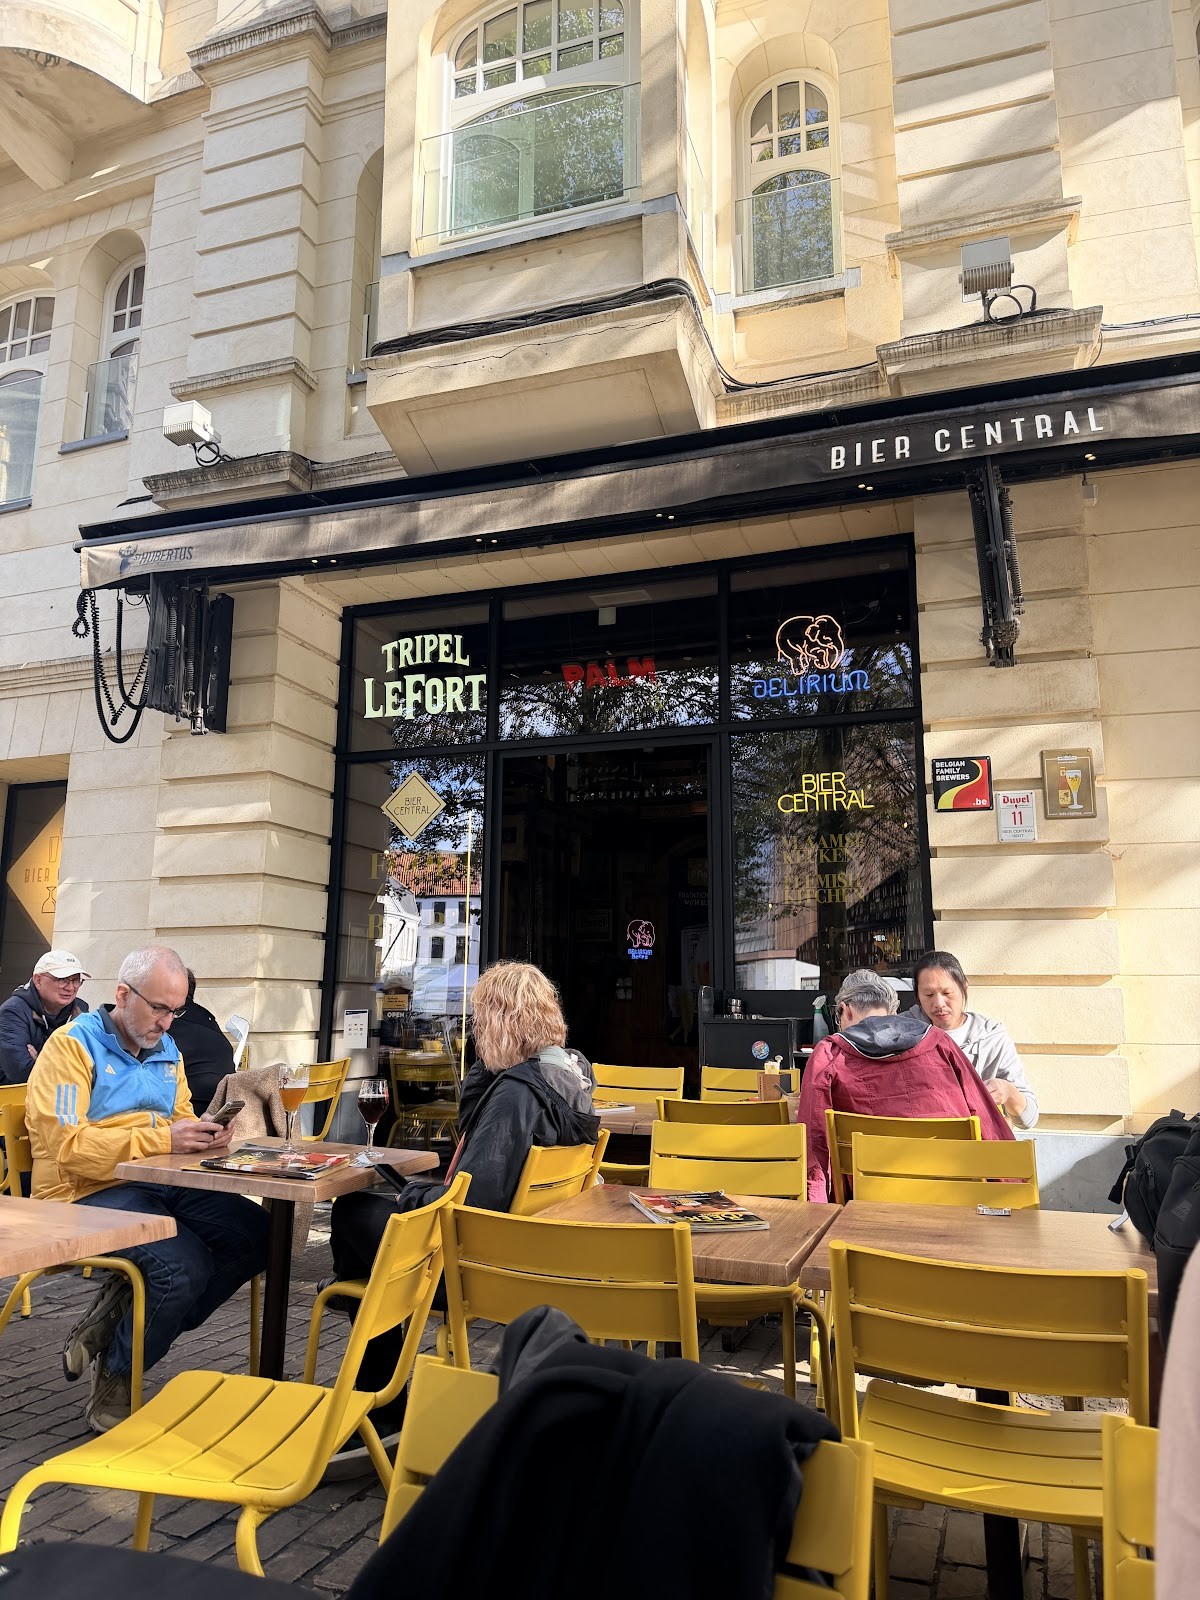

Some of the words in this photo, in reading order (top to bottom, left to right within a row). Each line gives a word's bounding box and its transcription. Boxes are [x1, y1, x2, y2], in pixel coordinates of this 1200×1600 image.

[830, 435, 910, 471] BIER
[934, 407, 1104, 453] CENTRAL
[140, 546, 194, 565] HUBERTUS
[381, 633, 470, 673] TRIPEL
[560, 655, 657, 692] PALM
[753, 669, 871, 699] DELIRIUM
[935, 760, 966, 768] BELGIAN
[935, 767, 961, 775] FAMILY
[801, 771, 847, 794] BIER
[935, 773, 970, 782] BREWERS
[404, 796, 422, 806] BIER
[777, 788, 875, 814] CENTRAL
[972, 797, 988, 807] .be
[1002, 794, 1030, 804] Duvel
[393, 805, 432, 816] CENTRAL
[1011, 810, 1023, 826] 11
[24, 867, 50, 883] BIER
[386, 1011, 405, 1019] OPEN
